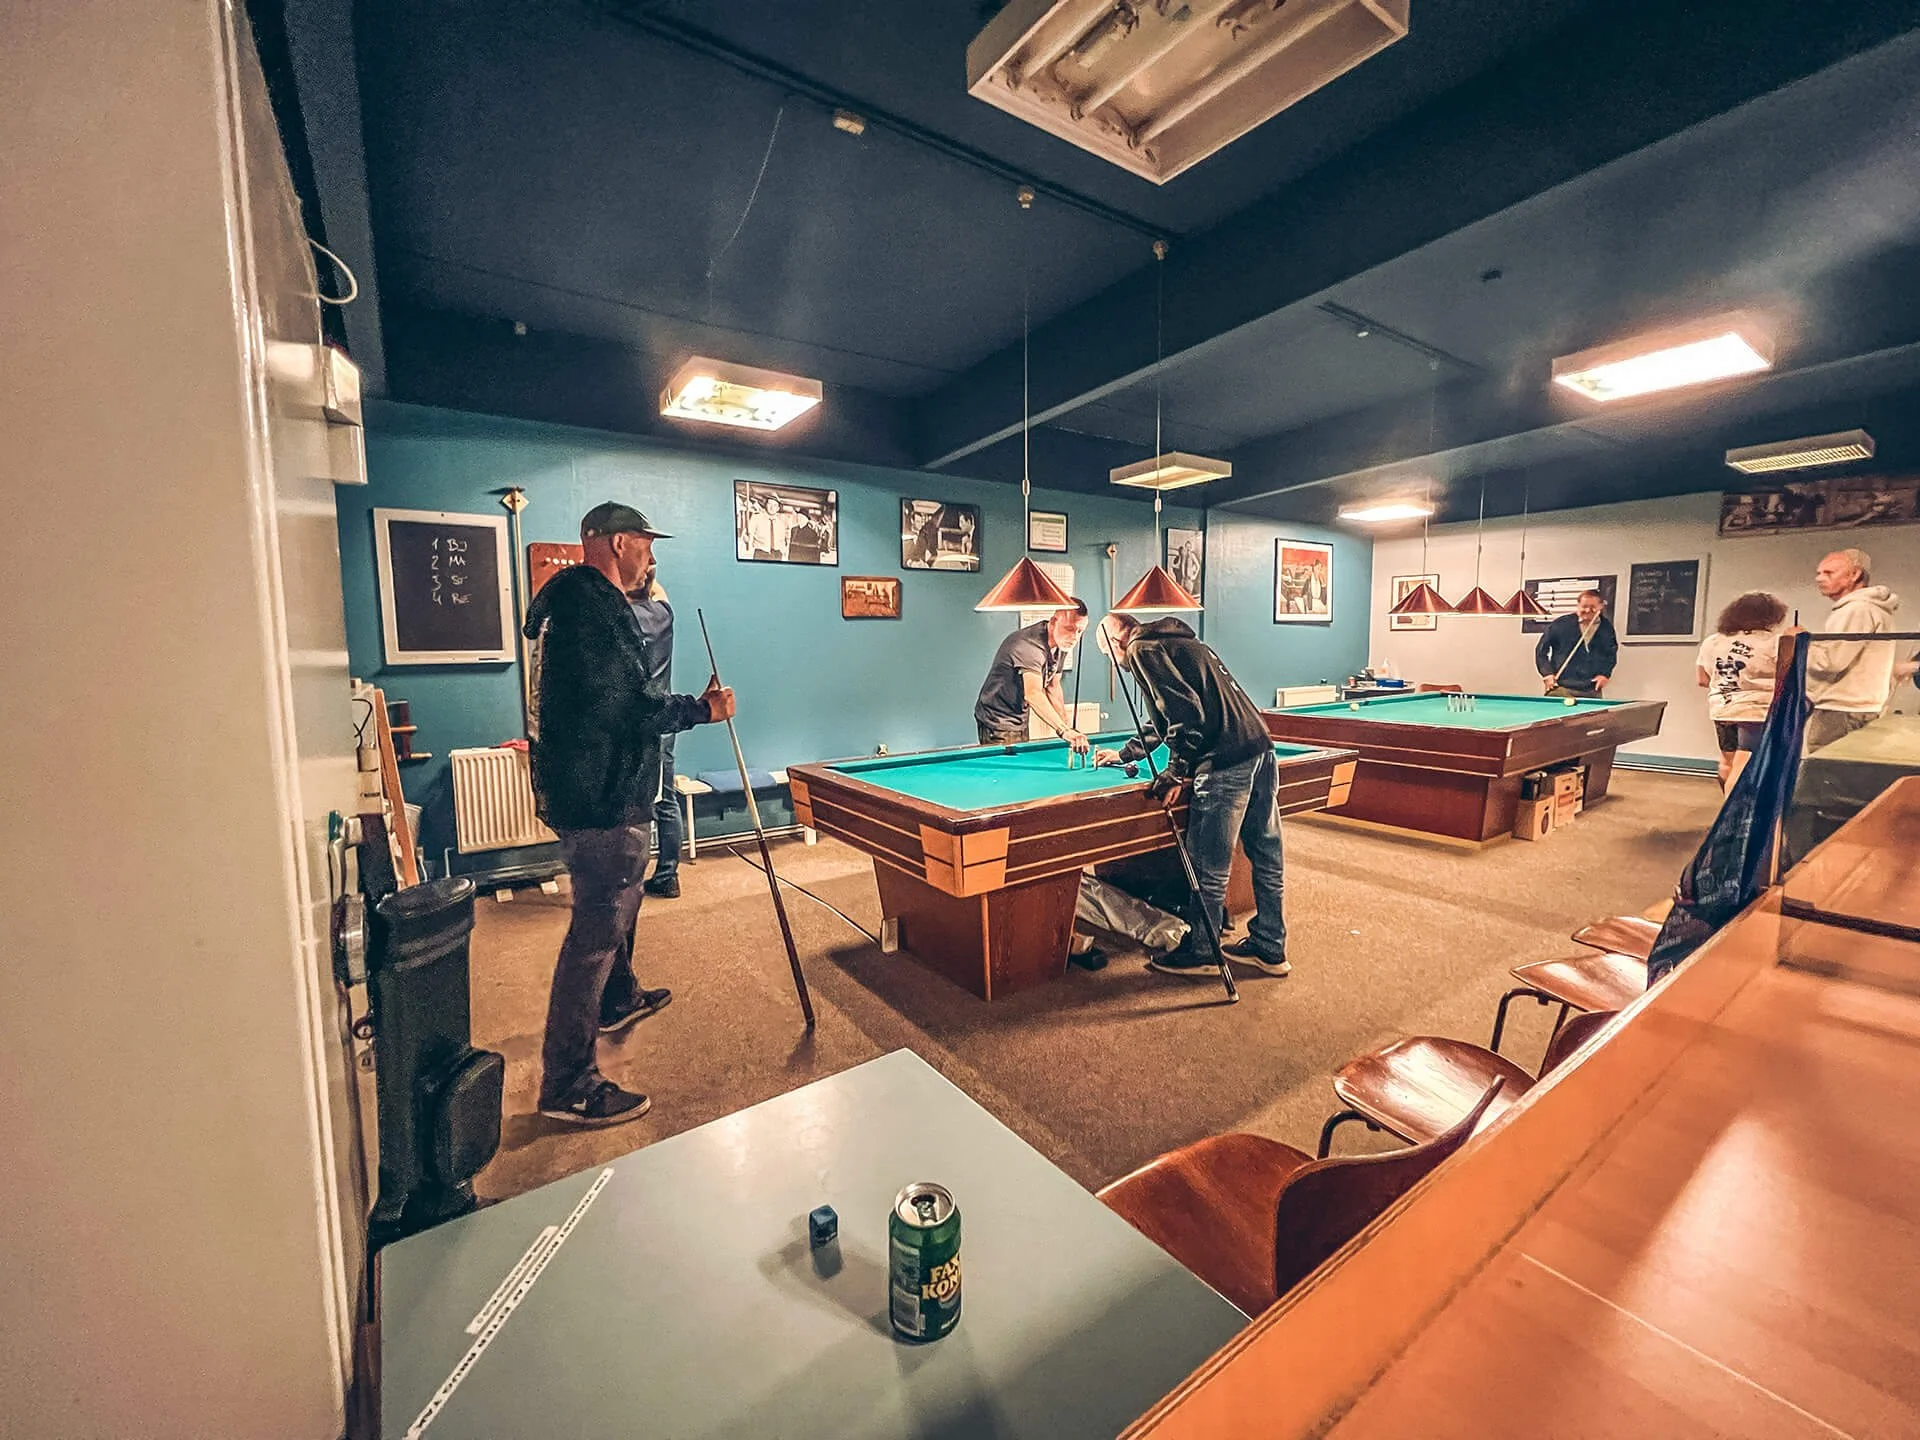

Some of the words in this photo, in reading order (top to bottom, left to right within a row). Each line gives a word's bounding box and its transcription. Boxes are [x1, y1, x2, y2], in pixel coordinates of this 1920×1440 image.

[431, 537, 439, 551] 1
[431, 555, 439, 570] 2
[431, 575, 442, 592] 3
[432, 591, 442, 605] 4
